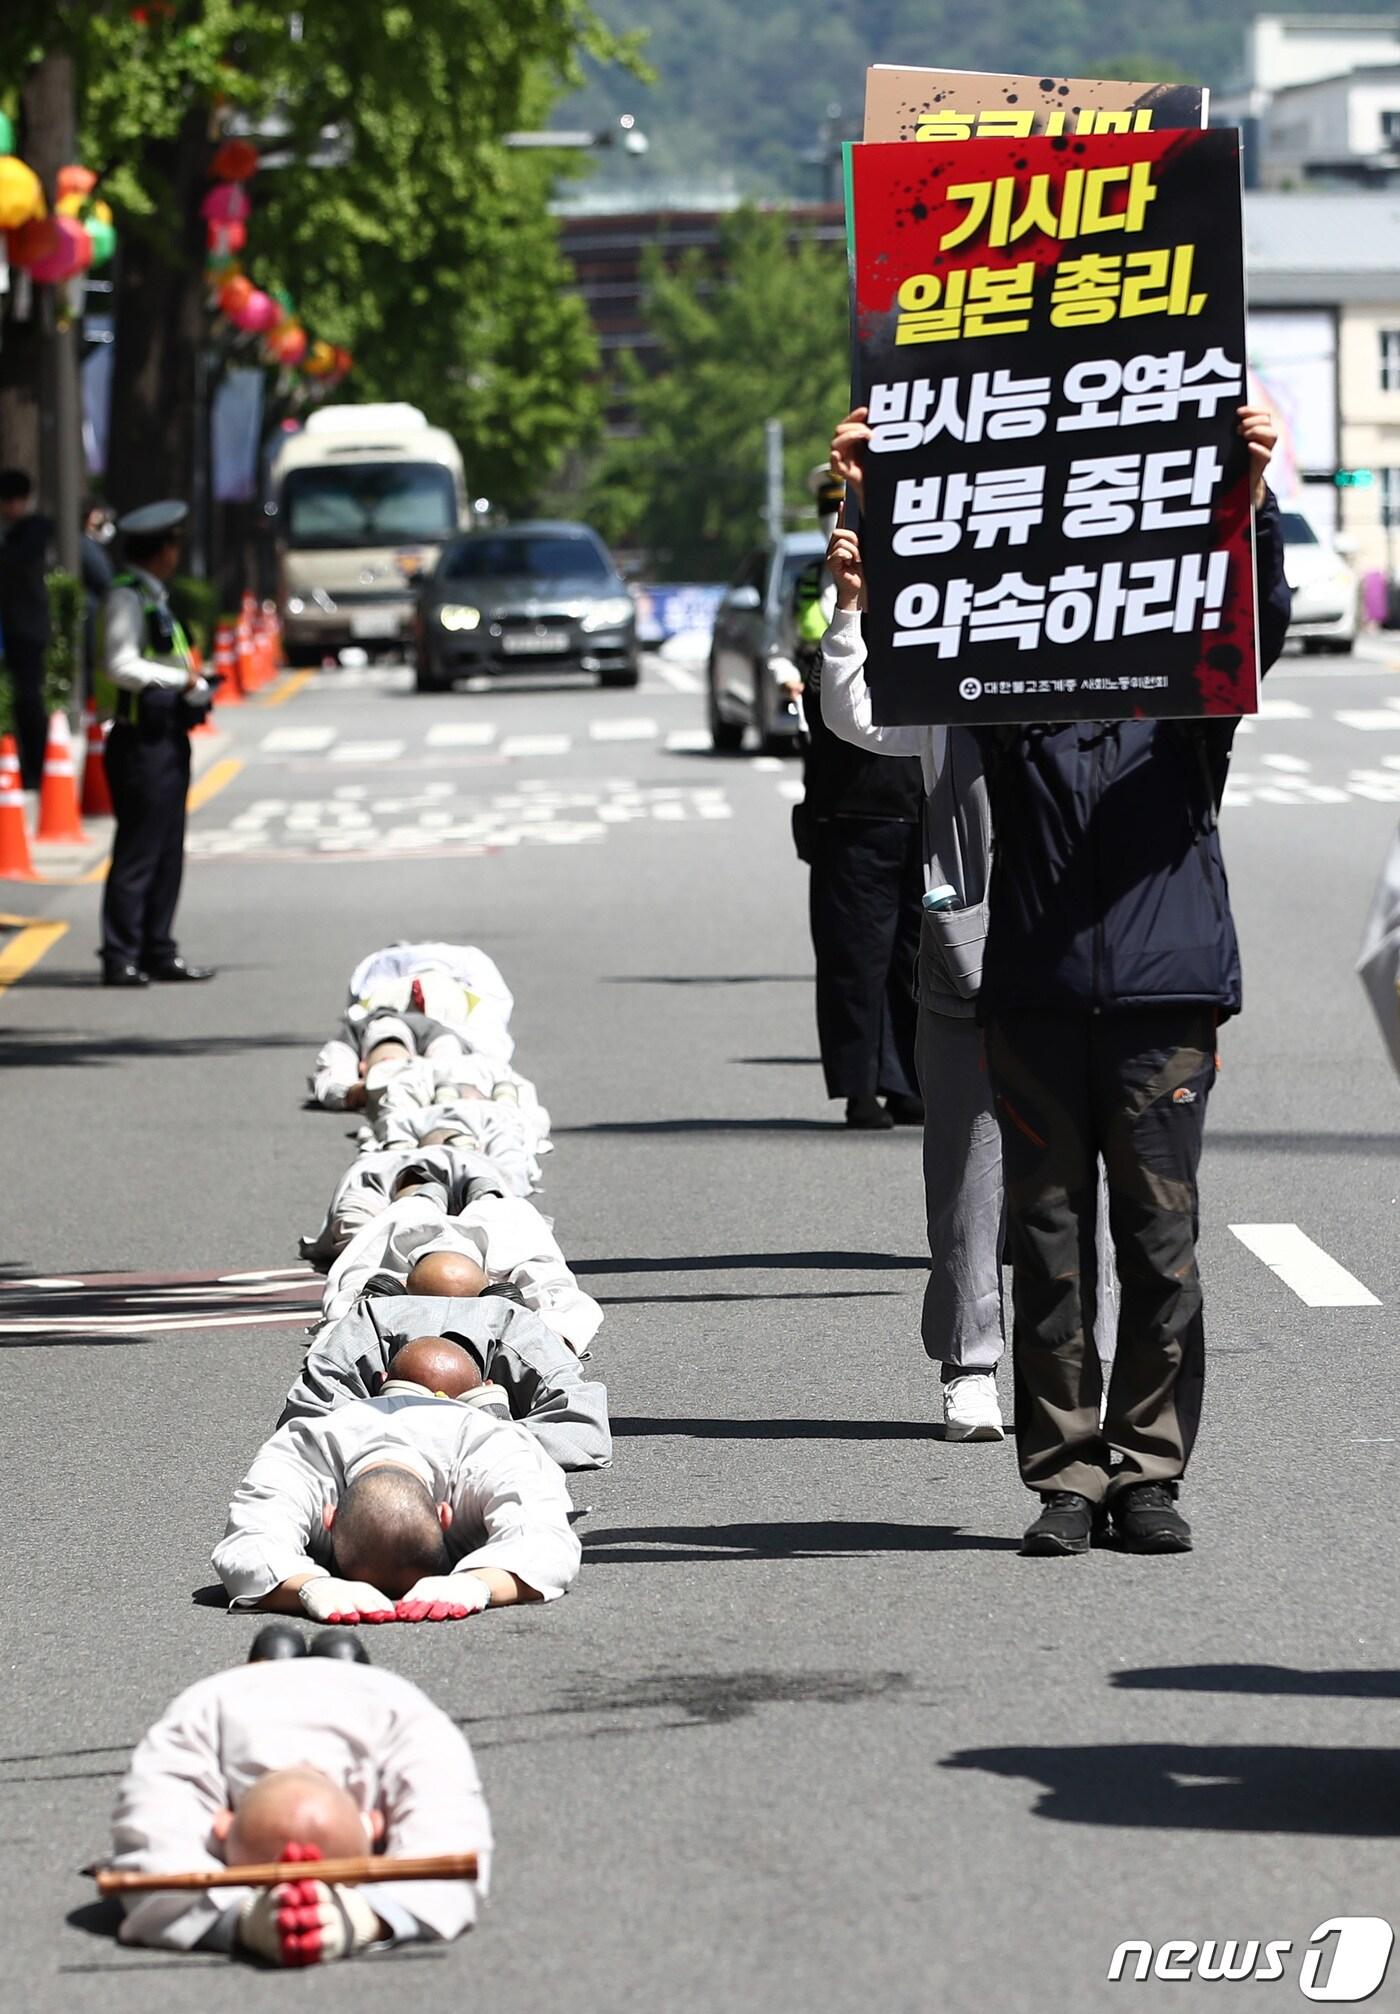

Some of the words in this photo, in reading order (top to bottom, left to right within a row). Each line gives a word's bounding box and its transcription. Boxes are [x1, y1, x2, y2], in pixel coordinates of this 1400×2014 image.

[940, 162, 1156, 251] 기시다
[895, 262, 1035, 345] 일본
[1050, 245, 1207, 328] 총리,
[868, 370, 1051, 452] 방사능
[1056, 347, 1242, 432] 오염수
[892, 466, 1046, 556] 방류
[1062, 446, 1223, 538] 중단
[892, 551, 1230, 659] 약속하라!
[984, 679, 1078, 695] 대한불교조계종
